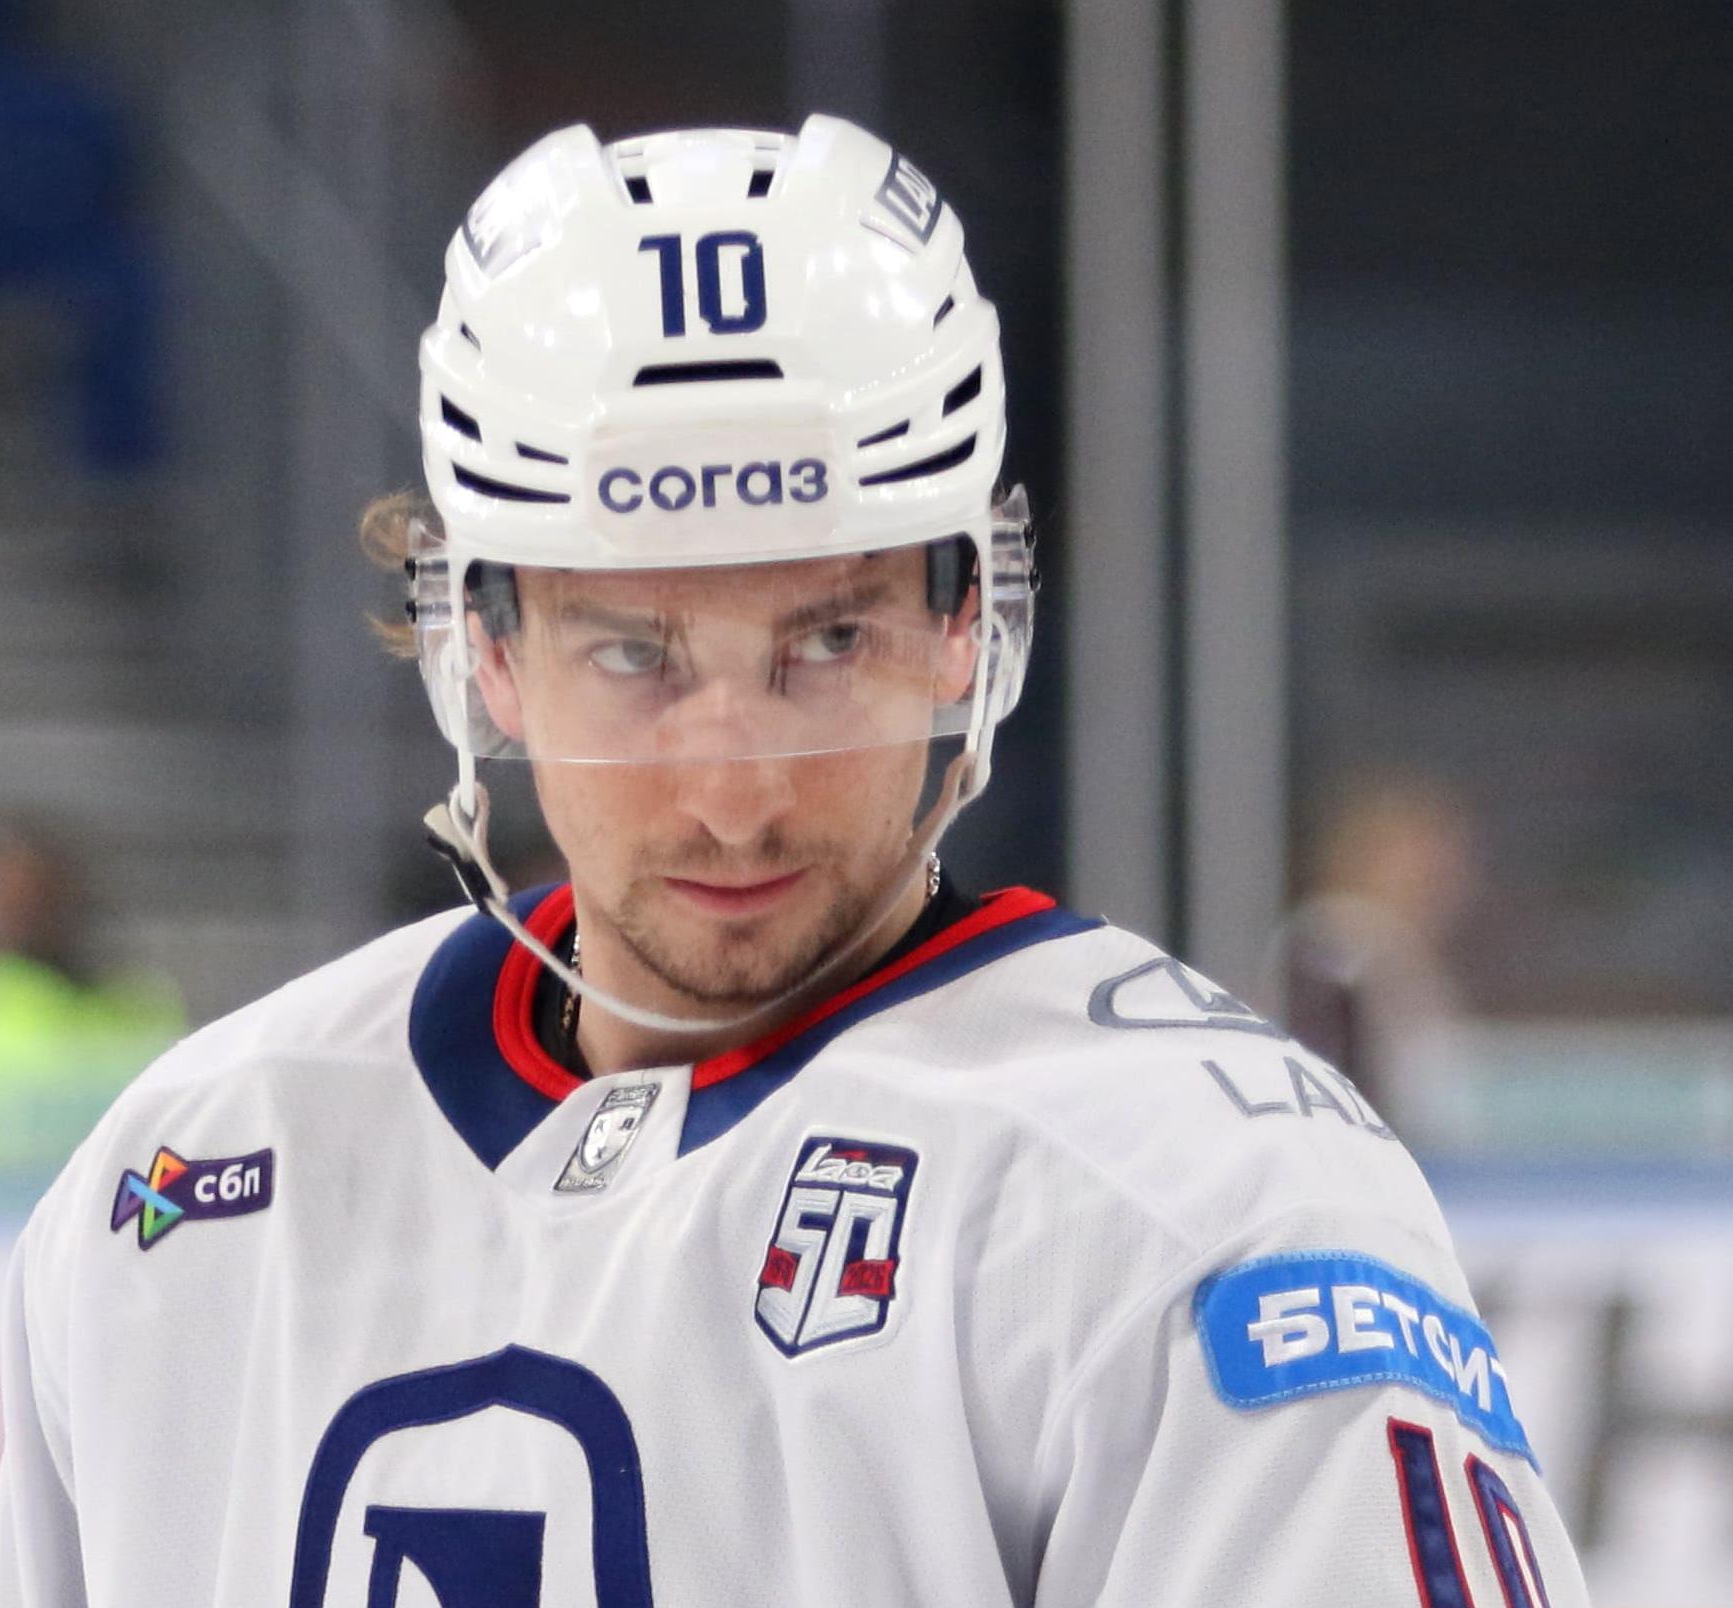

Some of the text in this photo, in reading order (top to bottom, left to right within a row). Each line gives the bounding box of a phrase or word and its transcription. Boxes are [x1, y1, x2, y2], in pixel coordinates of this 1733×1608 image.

[638, 230, 768, 338] 10
[597, 457, 829, 514] согаз
[194, 1163, 261, 1203] сбп
